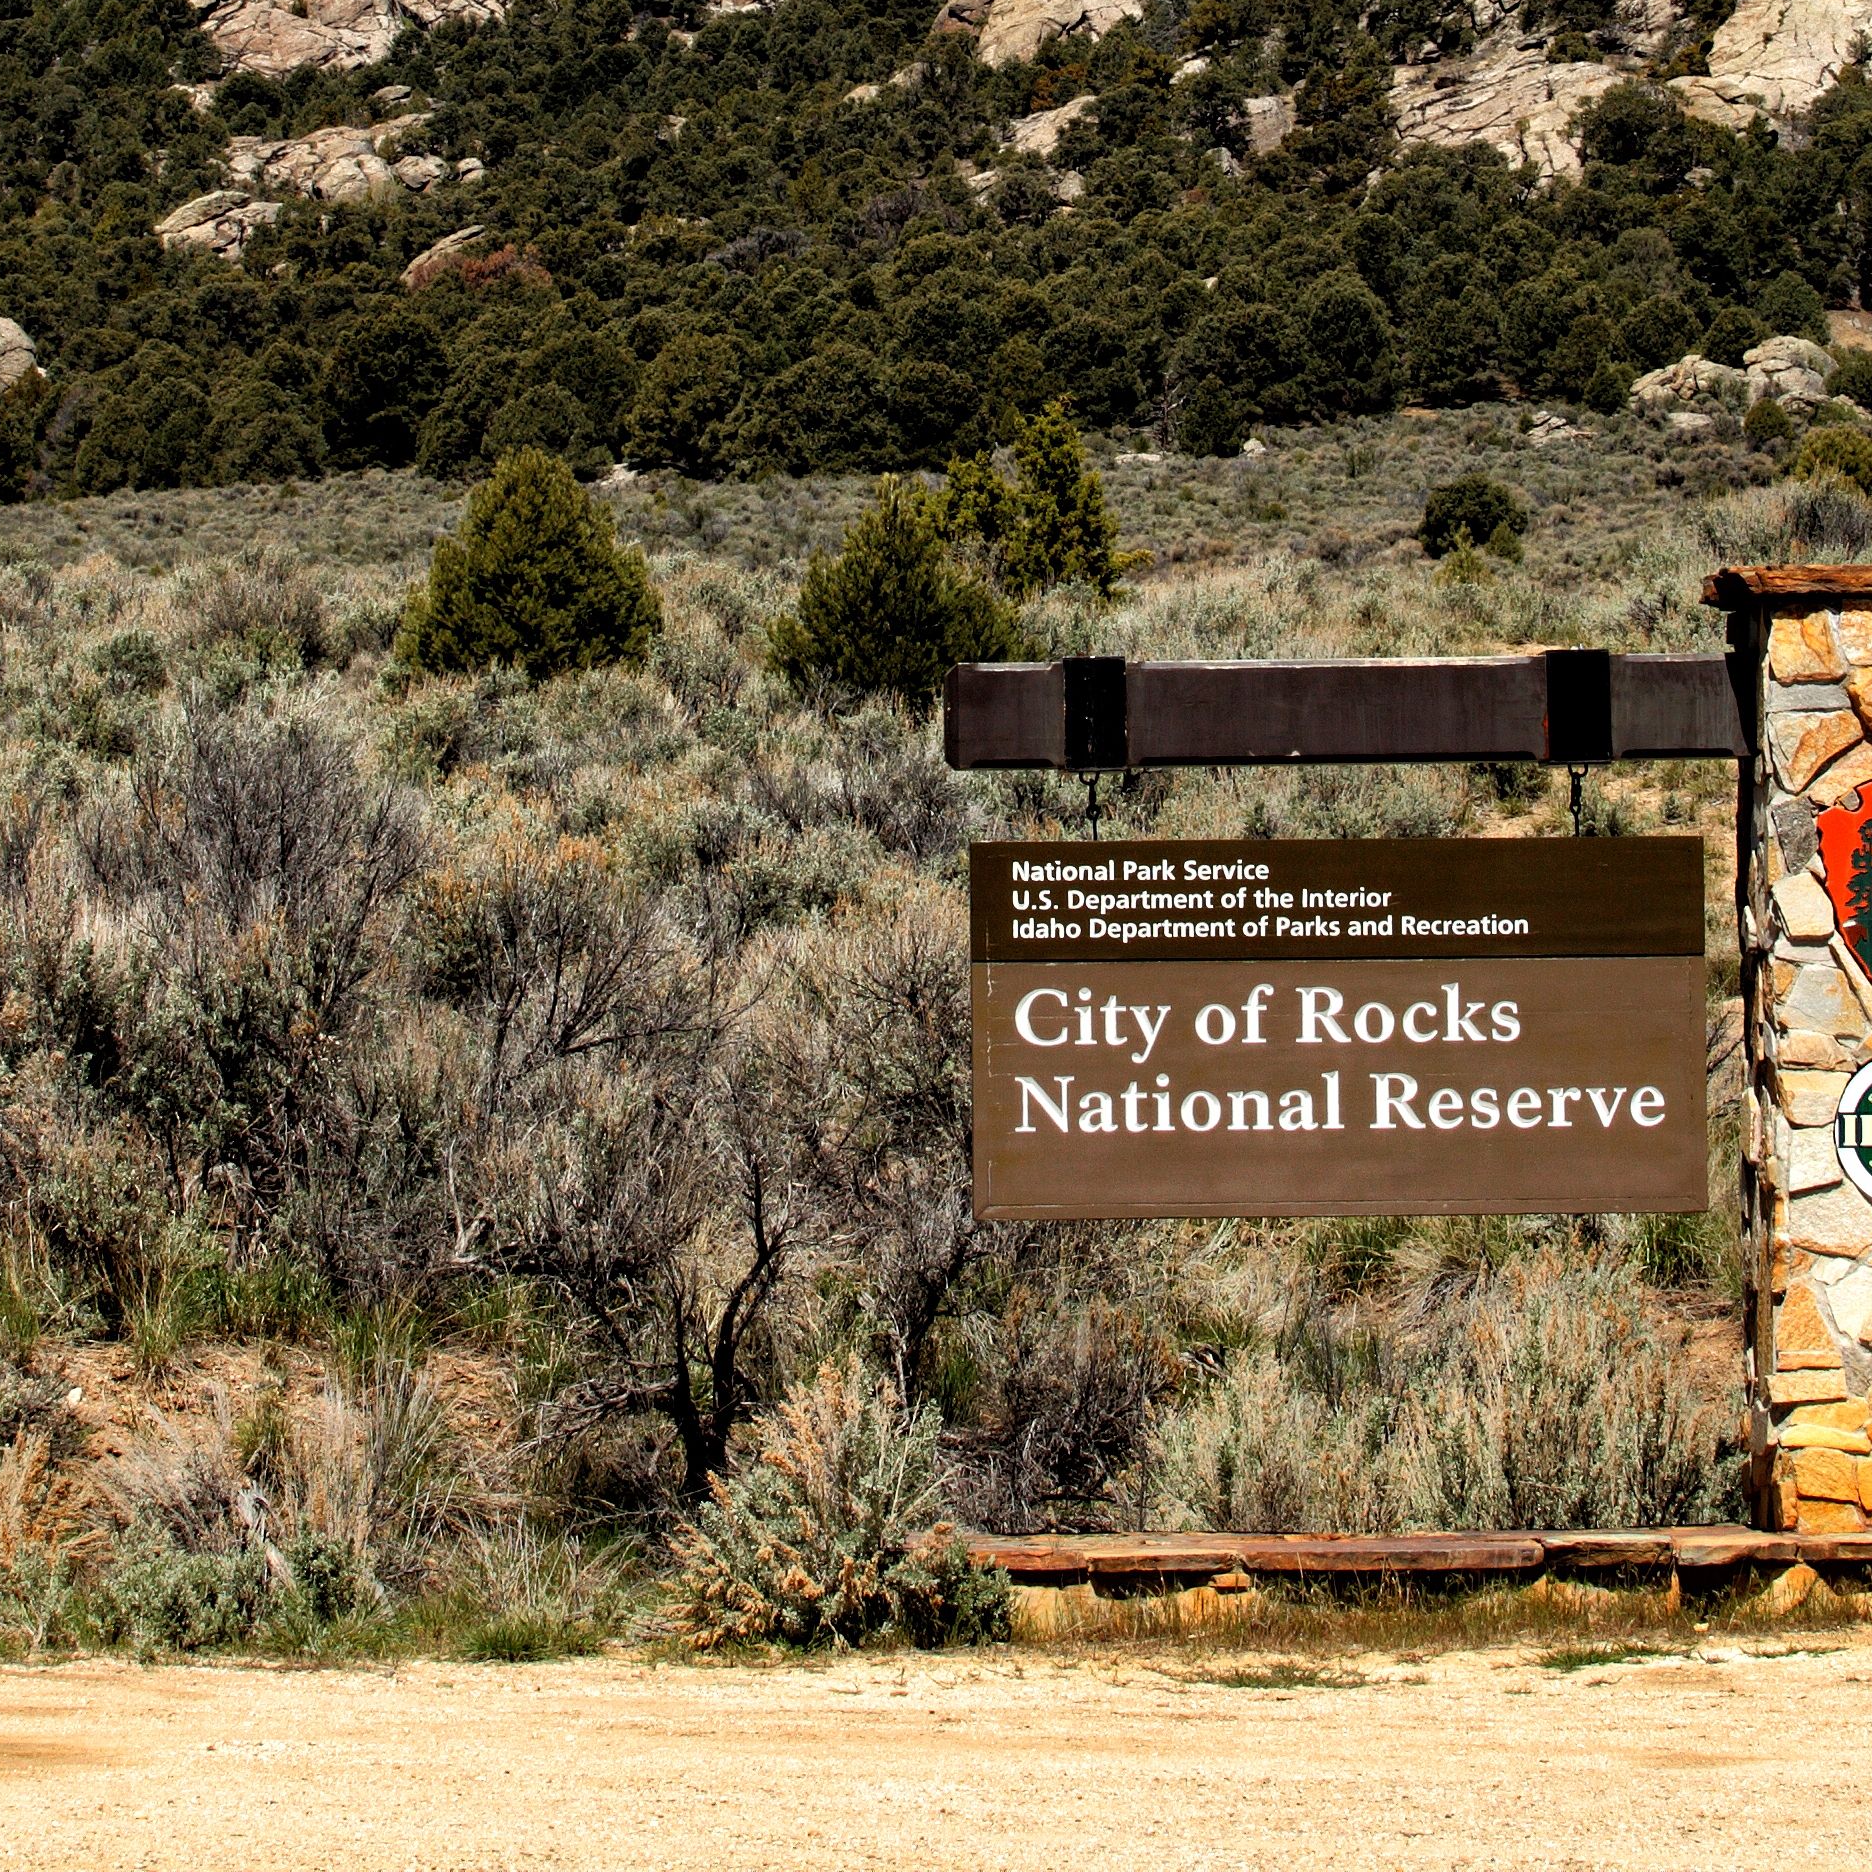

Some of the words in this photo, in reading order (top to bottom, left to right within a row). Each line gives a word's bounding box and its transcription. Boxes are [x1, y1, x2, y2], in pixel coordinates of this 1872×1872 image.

[1012, 859, 1115, 882] National
[1123, 859, 1176, 881] Park
[1183, 858, 1270, 881] Service
[1012, 889, 1059, 911] U.S.
[1067, 889, 1214, 915] Department
[1220, 886, 1247, 909] of
[1252, 886, 1294, 909] the
[1301, 886, 1392, 908] Interior
[1012, 917, 1082, 939] Idaho
[1089, 917, 1237, 944] Department
[1242, 915, 1269, 937] of
[1276, 915, 1341, 937] Parks
[1347, 914, 1393, 937] and
[1401, 913, 1529, 936] Recreation
[1014, 986, 1172, 1064] City
[1194, 983, 1275, 1046] of
[1294, 982, 1521, 1044] Rocks
[1014, 1070, 1345, 1134] National
[1369, 1072, 1666, 1130] Reserve
